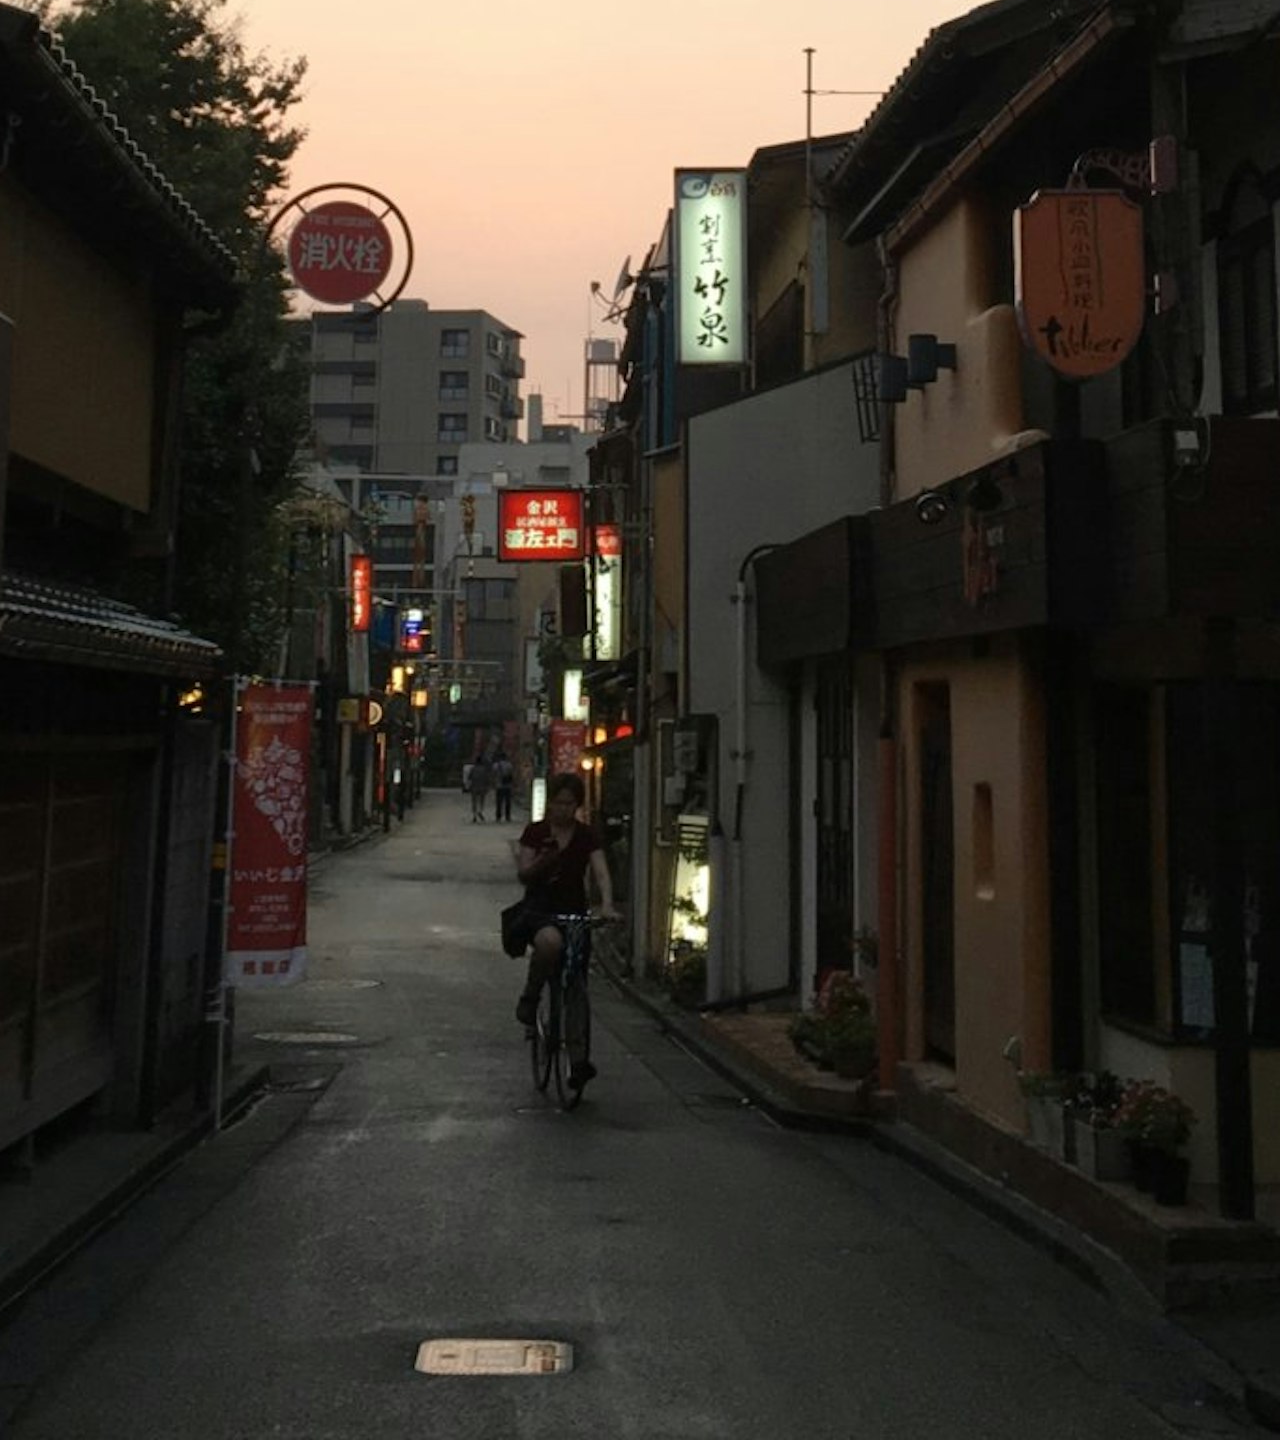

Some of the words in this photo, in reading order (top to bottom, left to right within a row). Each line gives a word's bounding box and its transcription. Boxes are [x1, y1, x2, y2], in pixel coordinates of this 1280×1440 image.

[299, 231, 384, 272] 消火栓
[527, 500, 558, 515] 金沢
